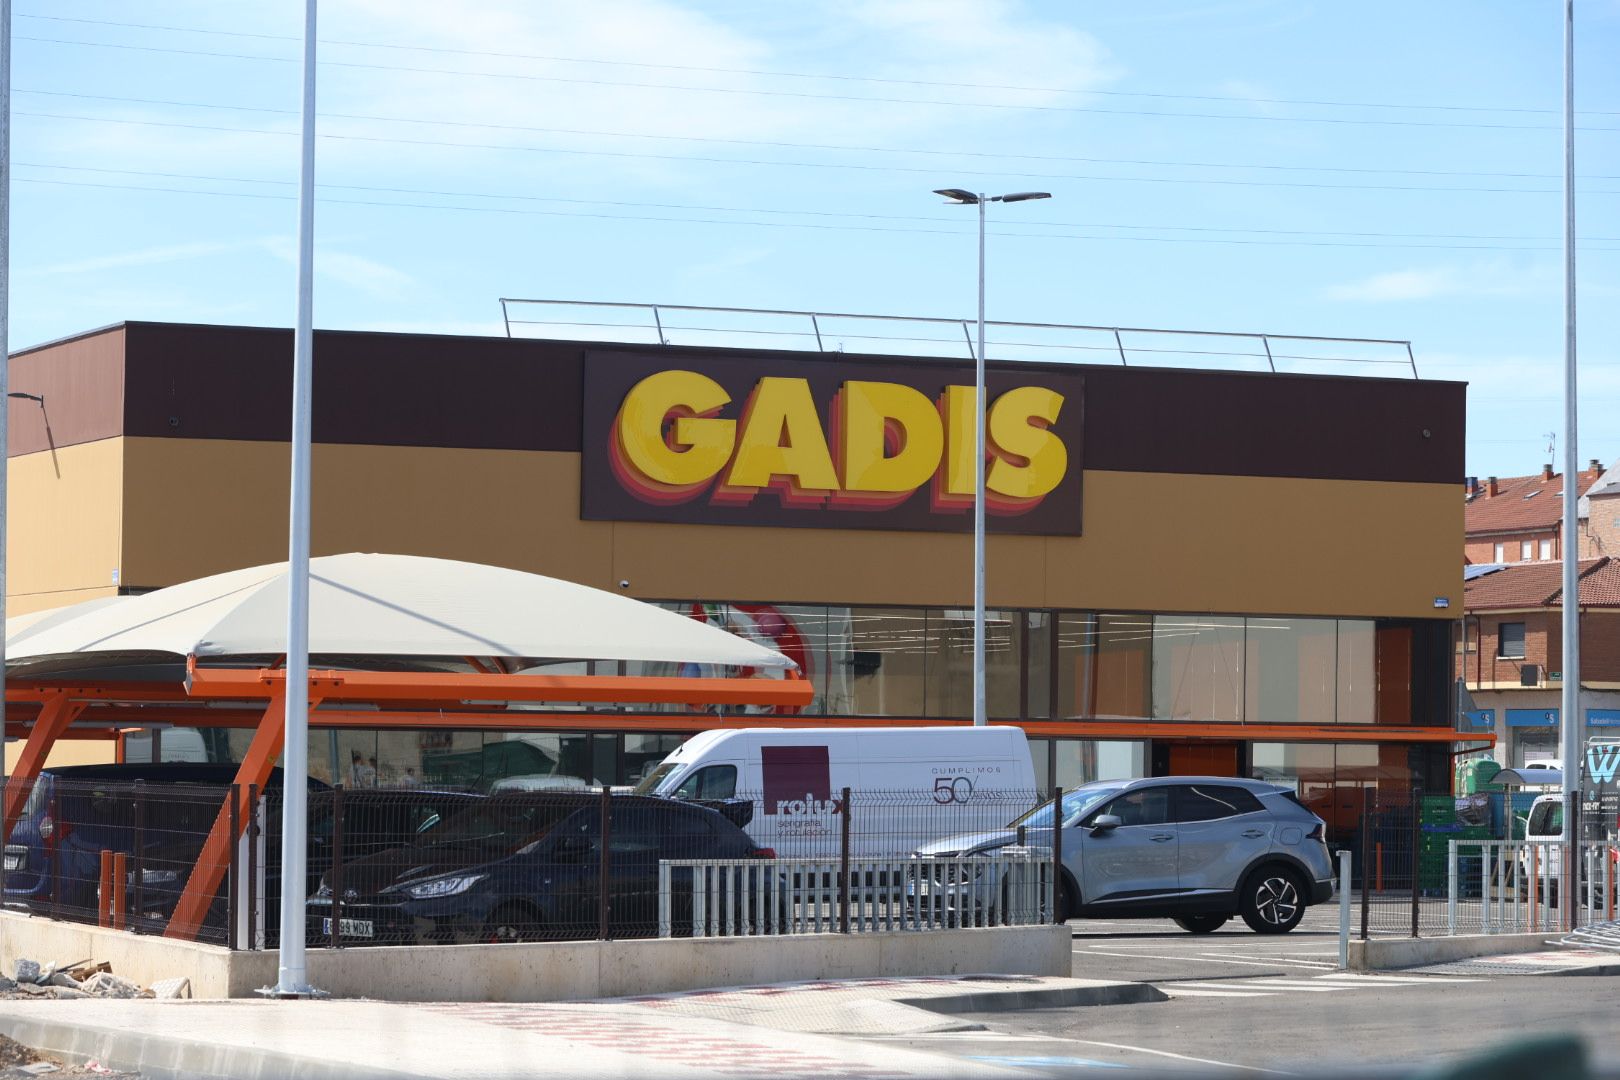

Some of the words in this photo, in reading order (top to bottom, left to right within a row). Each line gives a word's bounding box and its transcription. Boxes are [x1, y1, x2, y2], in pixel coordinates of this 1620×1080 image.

[610, 369, 1068, 514] GADIS
[931, 767, 1001, 775] CUMPLIMOS
[934, 776, 973, 804] 50
